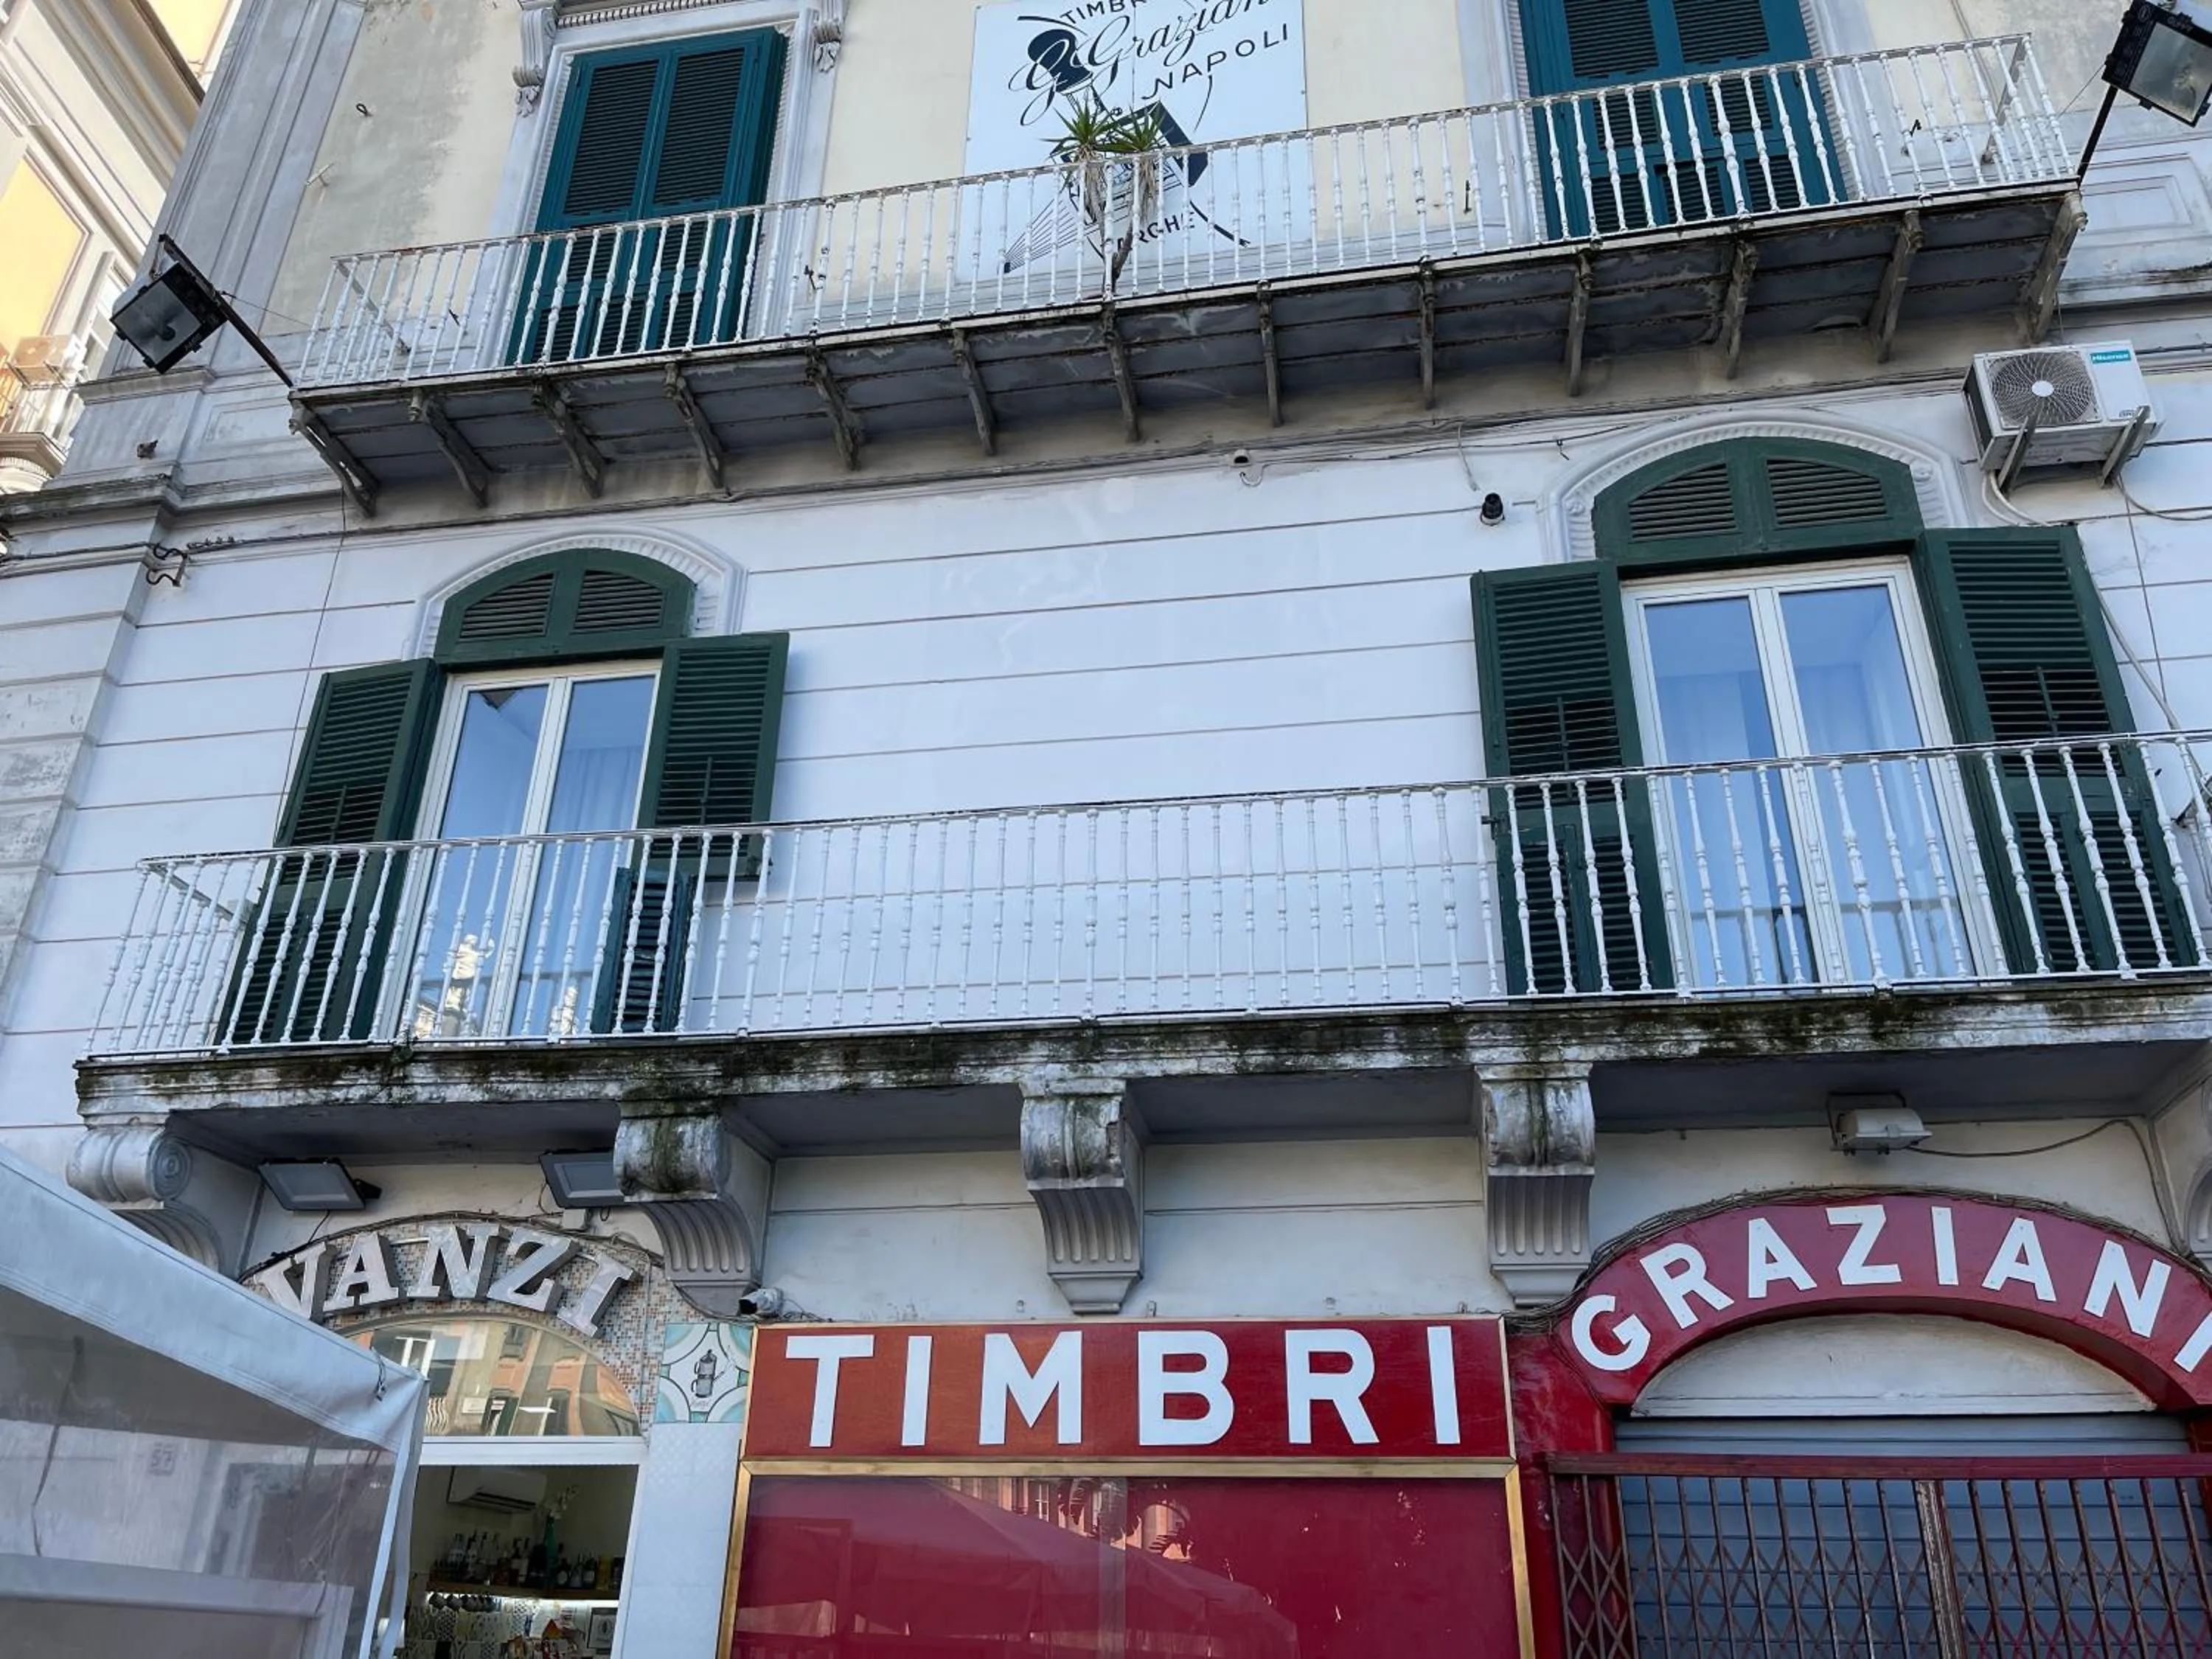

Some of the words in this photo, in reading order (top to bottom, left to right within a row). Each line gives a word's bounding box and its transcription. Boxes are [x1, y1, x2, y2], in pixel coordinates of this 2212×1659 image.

[1141, 23, 1288, 100] NAPOLI
[254, 1222, 636, 1338] VANZI
[1571, 1204, 2212, 1373] GRAZIANI
[785, 1325, 1461, 1448] TIMBRI
